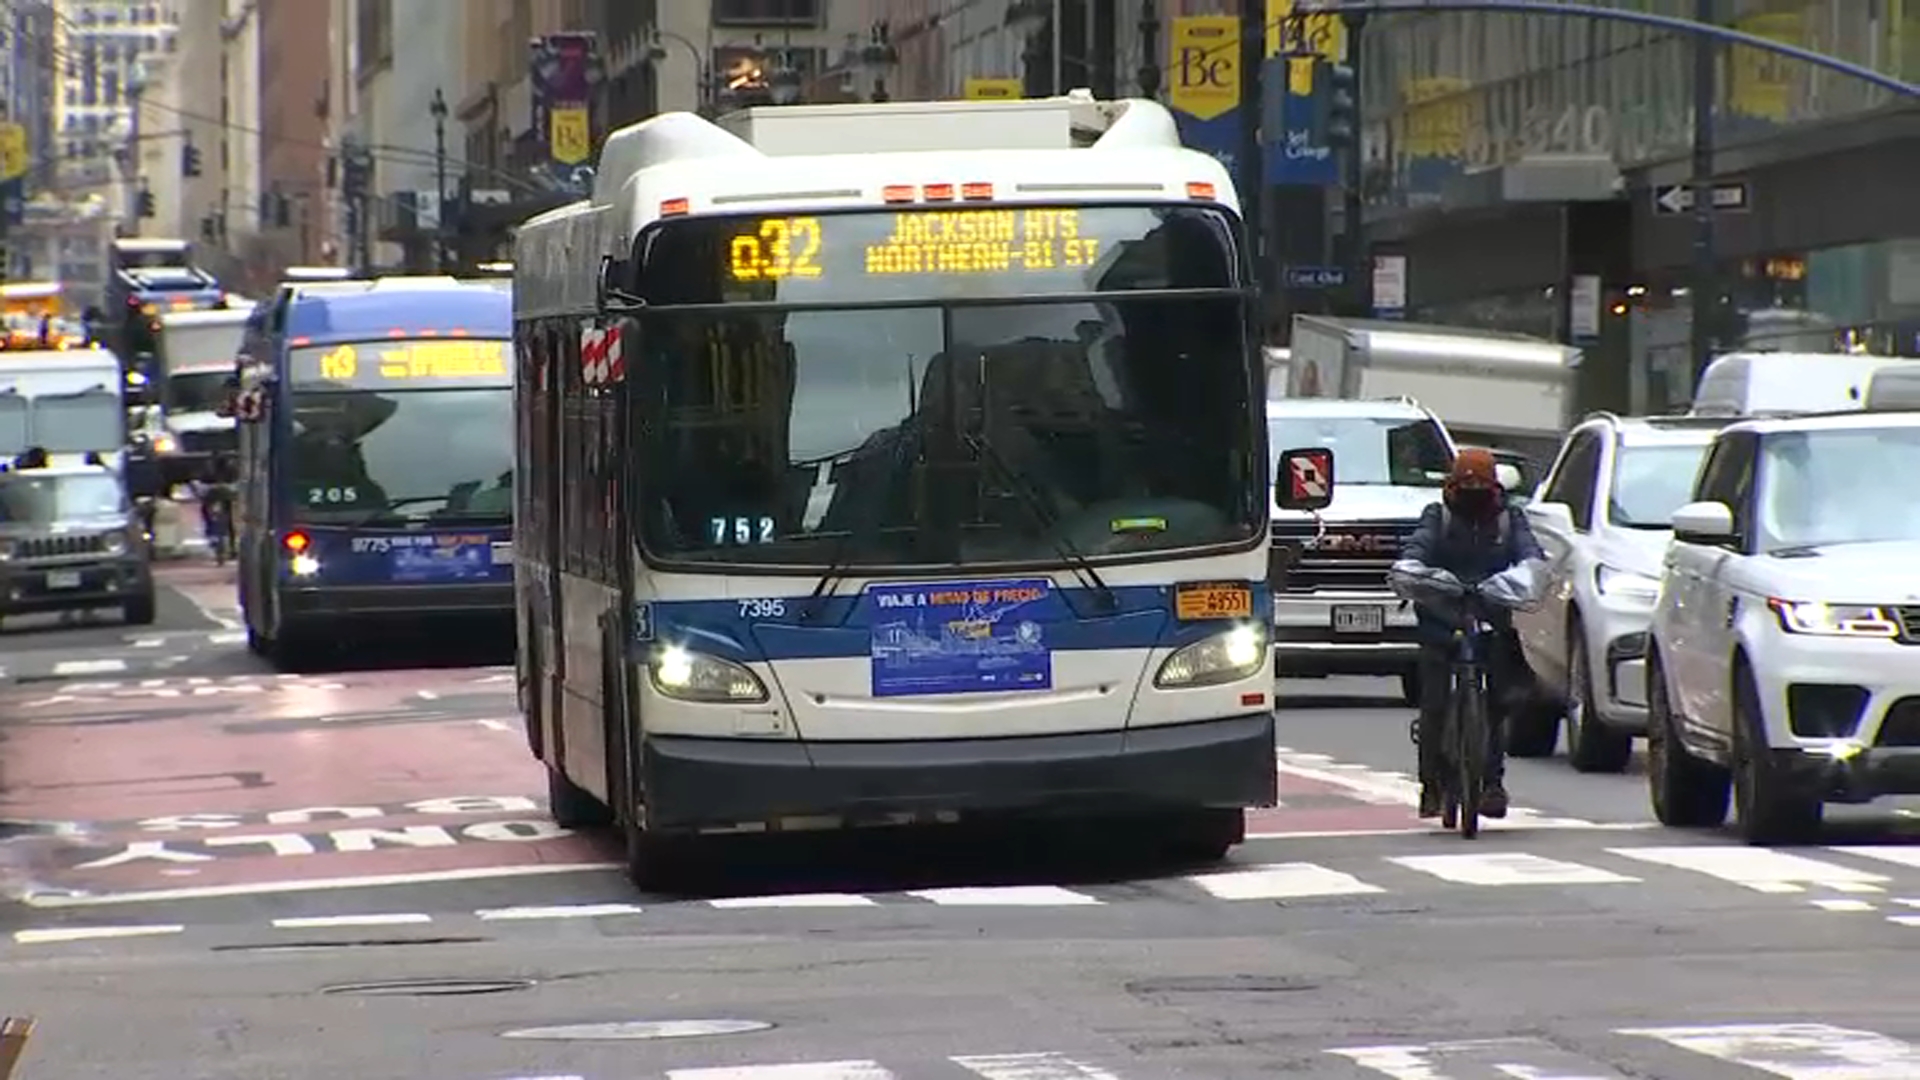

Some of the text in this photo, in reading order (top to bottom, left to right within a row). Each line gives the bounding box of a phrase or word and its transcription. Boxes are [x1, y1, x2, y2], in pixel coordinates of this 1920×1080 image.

[1180, 47, 1232, 87] Be
[887, 209, 1078, 244] JACKSON HTS
[1065, 239, 1098, 267] ST
[737, 599, 785, 618] 7395
[877, 593, 915, 608] VIAJE
[917, 594, 926, 607] A
[138, 796, 538, 831] BUS
[74, 820, 575, 870] ONLY
